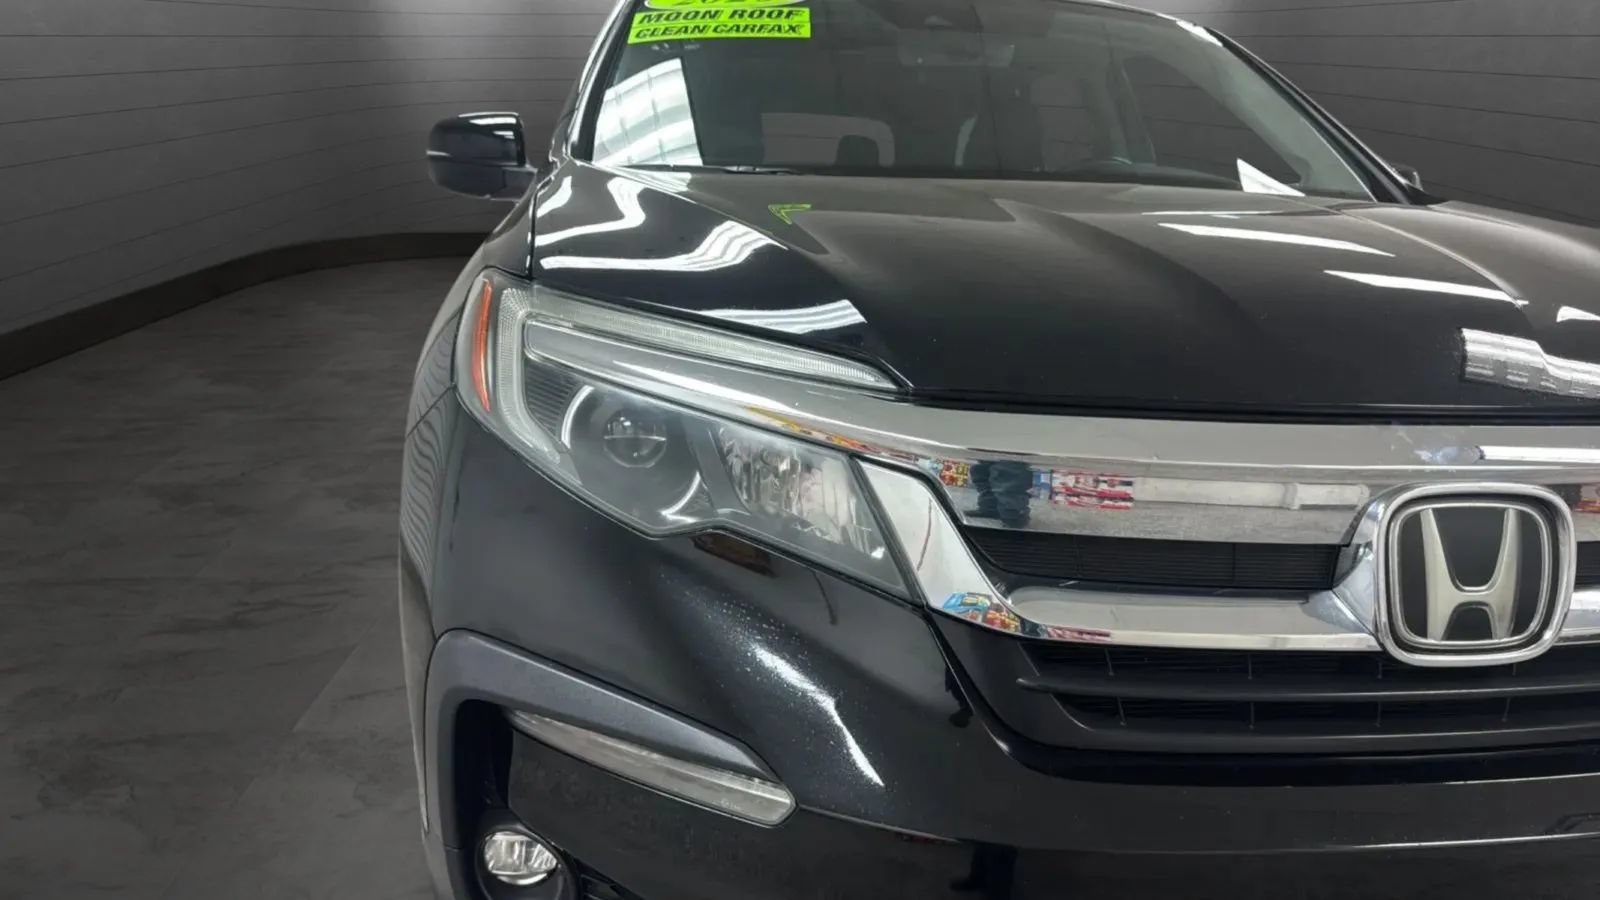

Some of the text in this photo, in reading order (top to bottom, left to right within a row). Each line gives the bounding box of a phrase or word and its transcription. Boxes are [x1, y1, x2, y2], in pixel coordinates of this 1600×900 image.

[639, 9, 805, 24] MOON ROOF
[635, 22, 803, 40] CLEAN CARFAX
